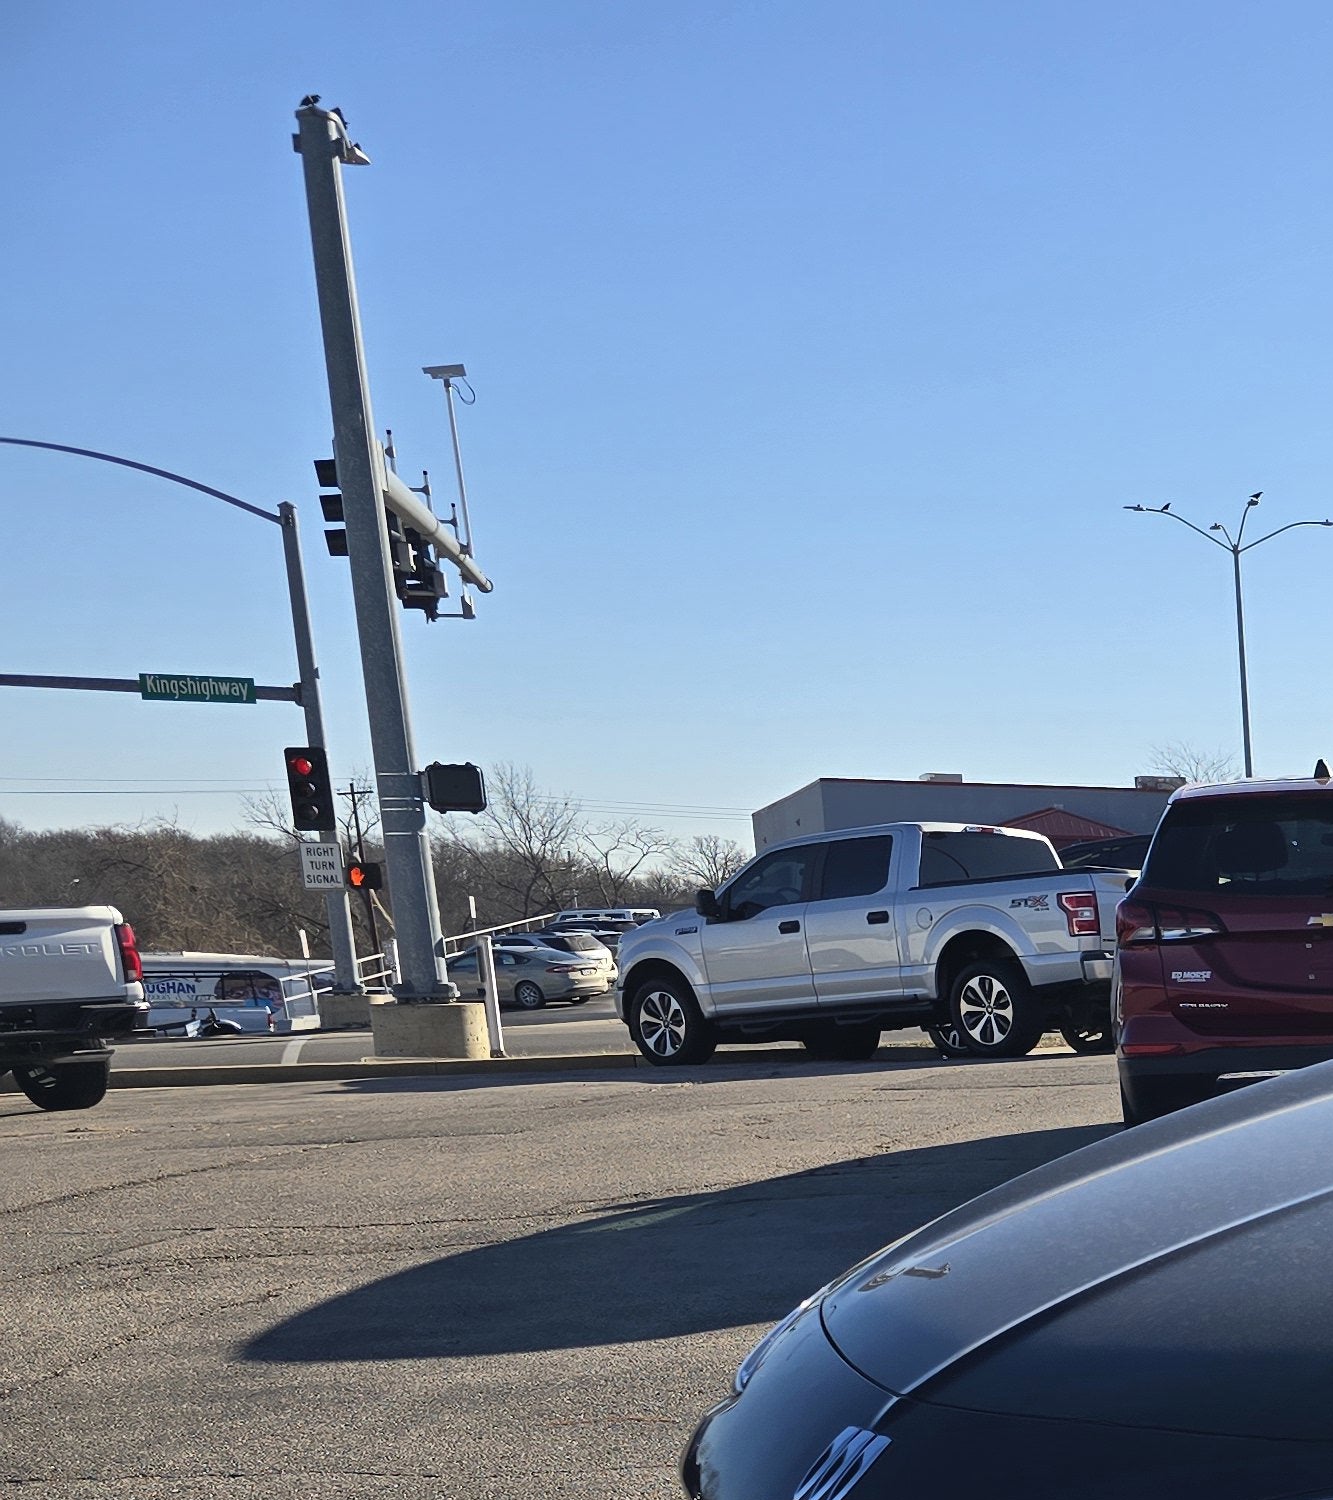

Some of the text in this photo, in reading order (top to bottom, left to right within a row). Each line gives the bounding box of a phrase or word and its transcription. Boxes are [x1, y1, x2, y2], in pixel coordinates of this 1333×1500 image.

[146, 675, 248, 701] Kingshighway
[306, 847, 335, 857] RIGHT
[310, 861, 335, 870] TURN
[306, 874, 342, 884] SIGNAL
[1009, 895, 1049, 908] STX
